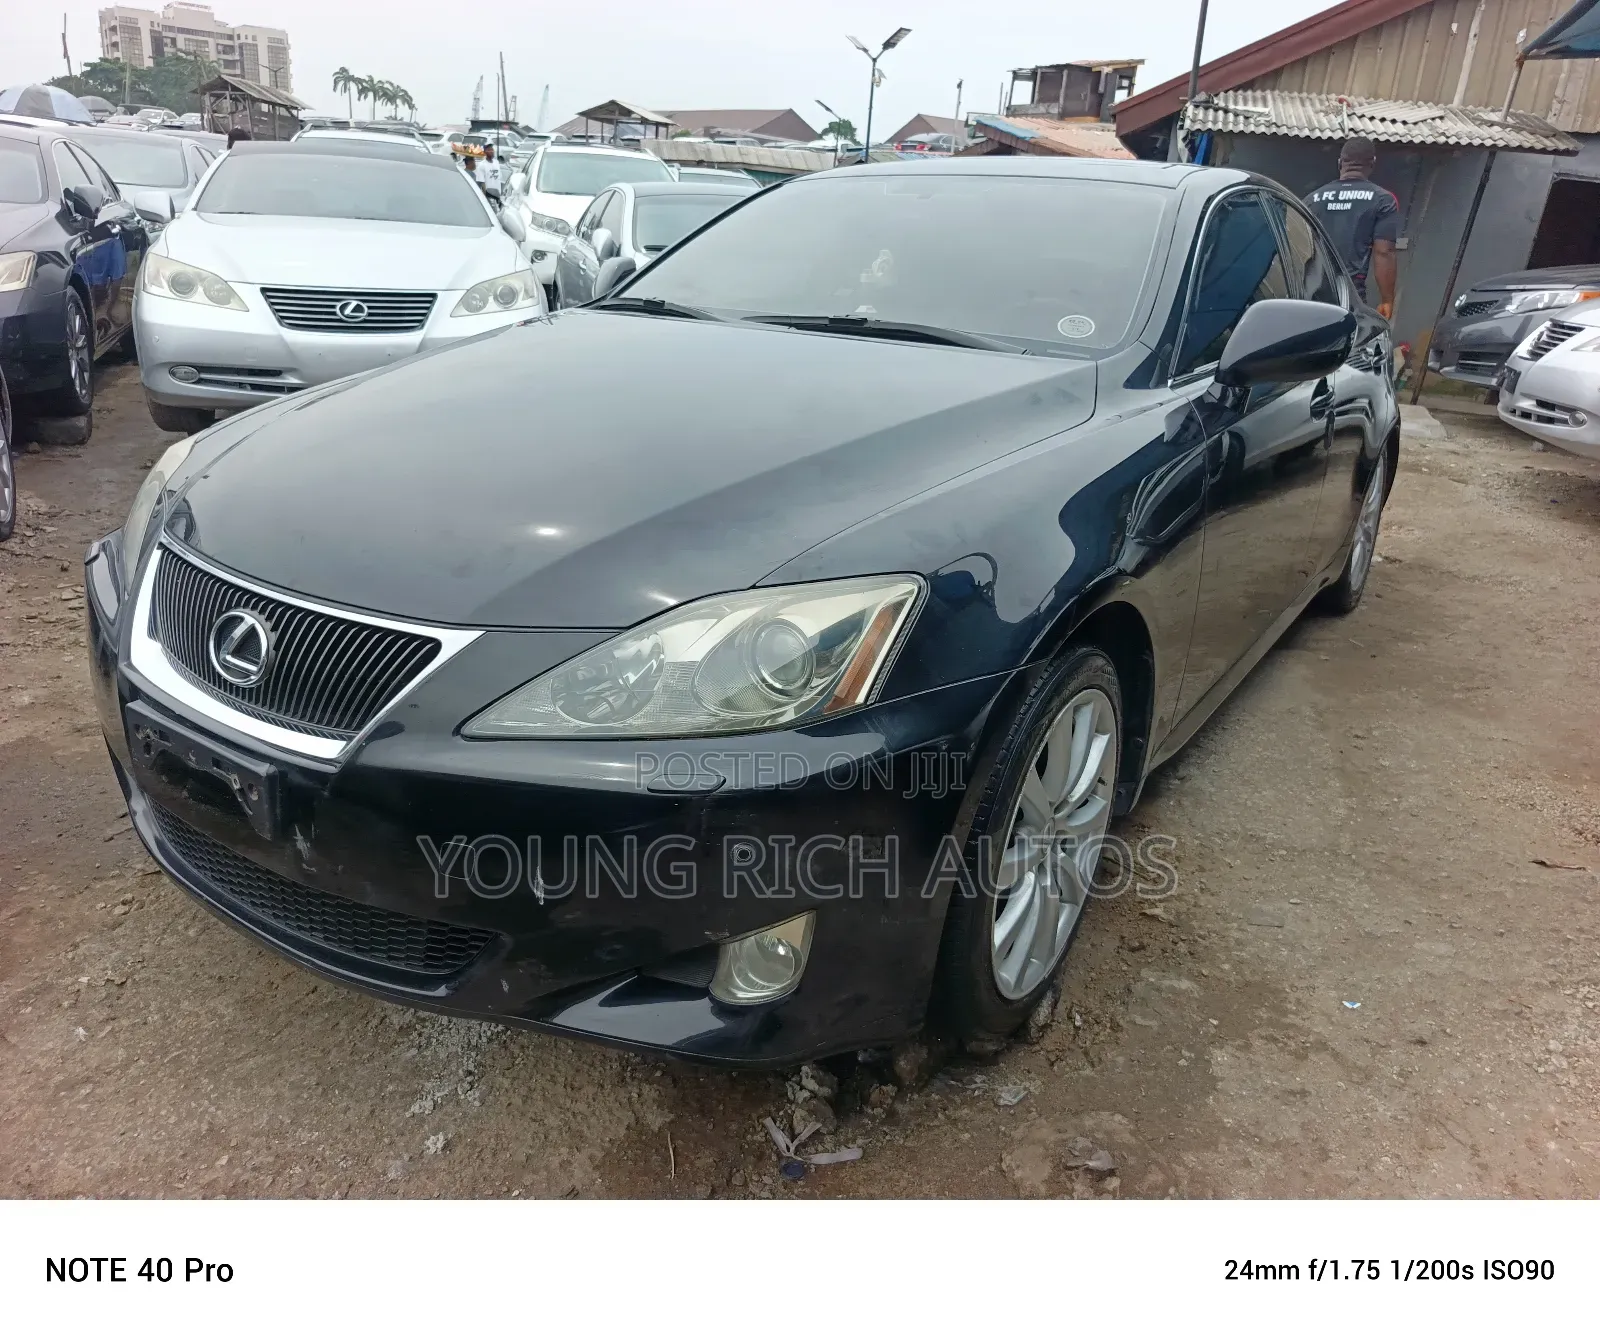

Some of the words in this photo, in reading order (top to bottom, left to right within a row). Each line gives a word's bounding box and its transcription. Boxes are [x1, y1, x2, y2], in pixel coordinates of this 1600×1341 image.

[1322, 191, 1336, 201] FC
[1338, 190, 1374, 201] UNION
[1327, 203, 1352, 211] BERLIN
